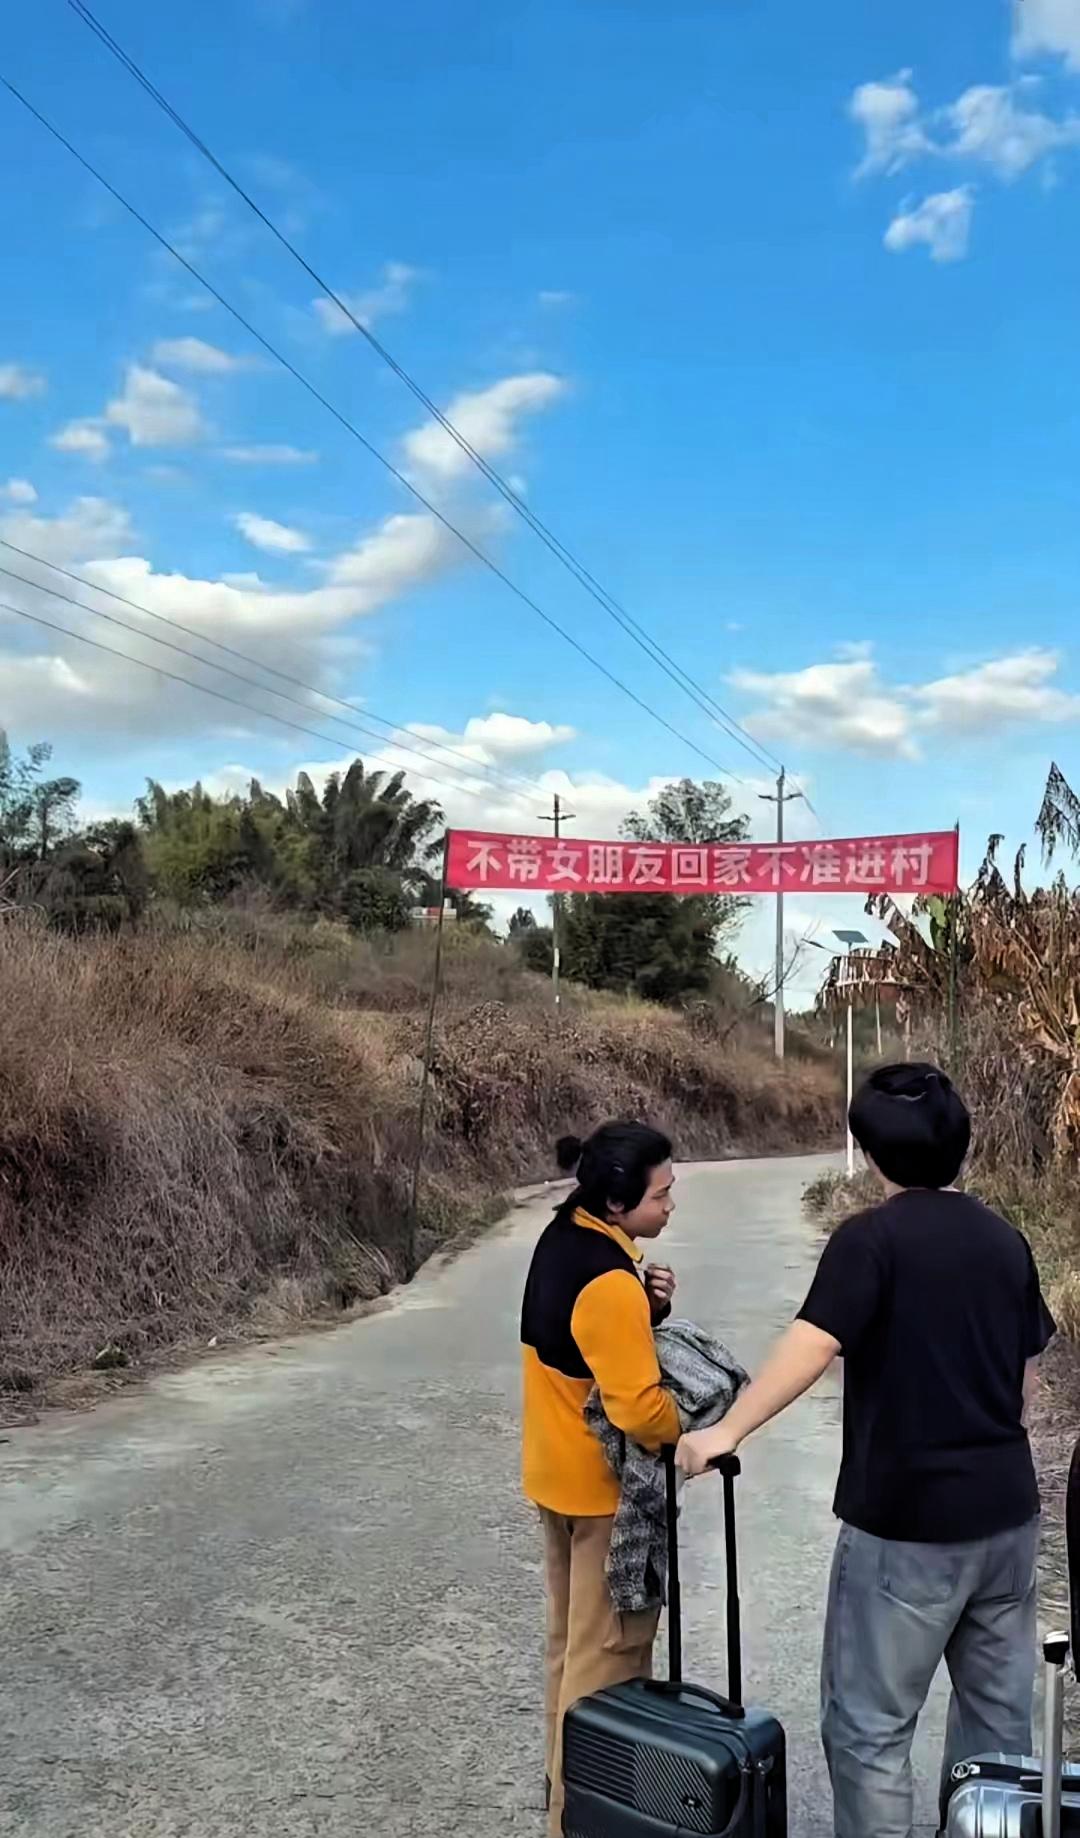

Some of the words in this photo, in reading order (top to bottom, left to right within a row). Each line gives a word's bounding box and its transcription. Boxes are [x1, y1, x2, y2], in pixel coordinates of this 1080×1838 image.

[466, 839, 932, 886] 不带女朋友回家不准进村
